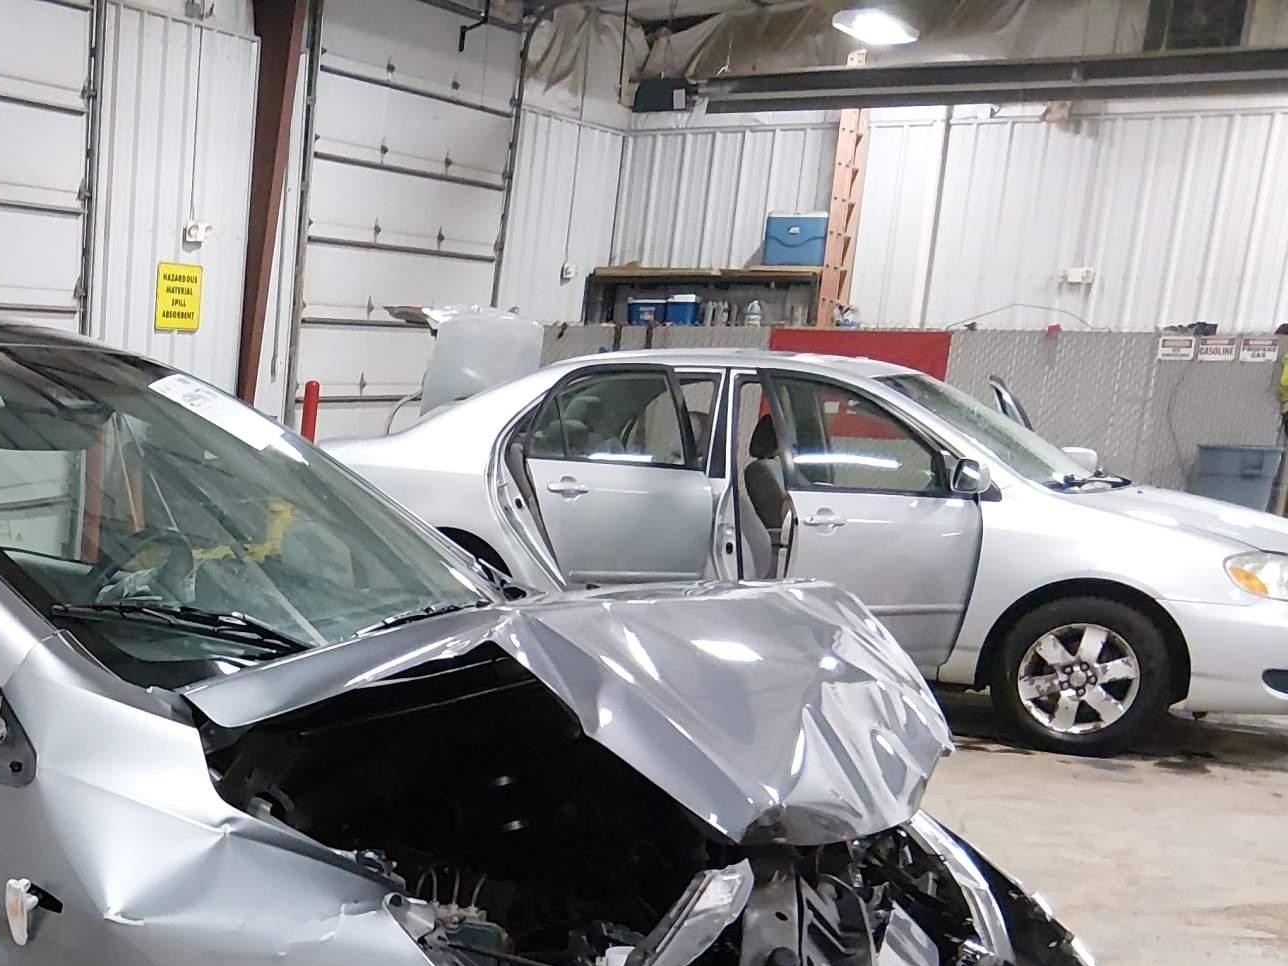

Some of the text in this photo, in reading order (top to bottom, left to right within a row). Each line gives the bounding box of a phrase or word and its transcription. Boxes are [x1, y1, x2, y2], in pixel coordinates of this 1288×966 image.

[163, 273, 197, 284] HAZARDOUS
[166, 286, 193, 295] MATERIAL
[171, 298, 186, 307] SPILL
[162, 310, 194, 320] ABSORBENT
[1199, 346, 1233, 355] GASOLINE
